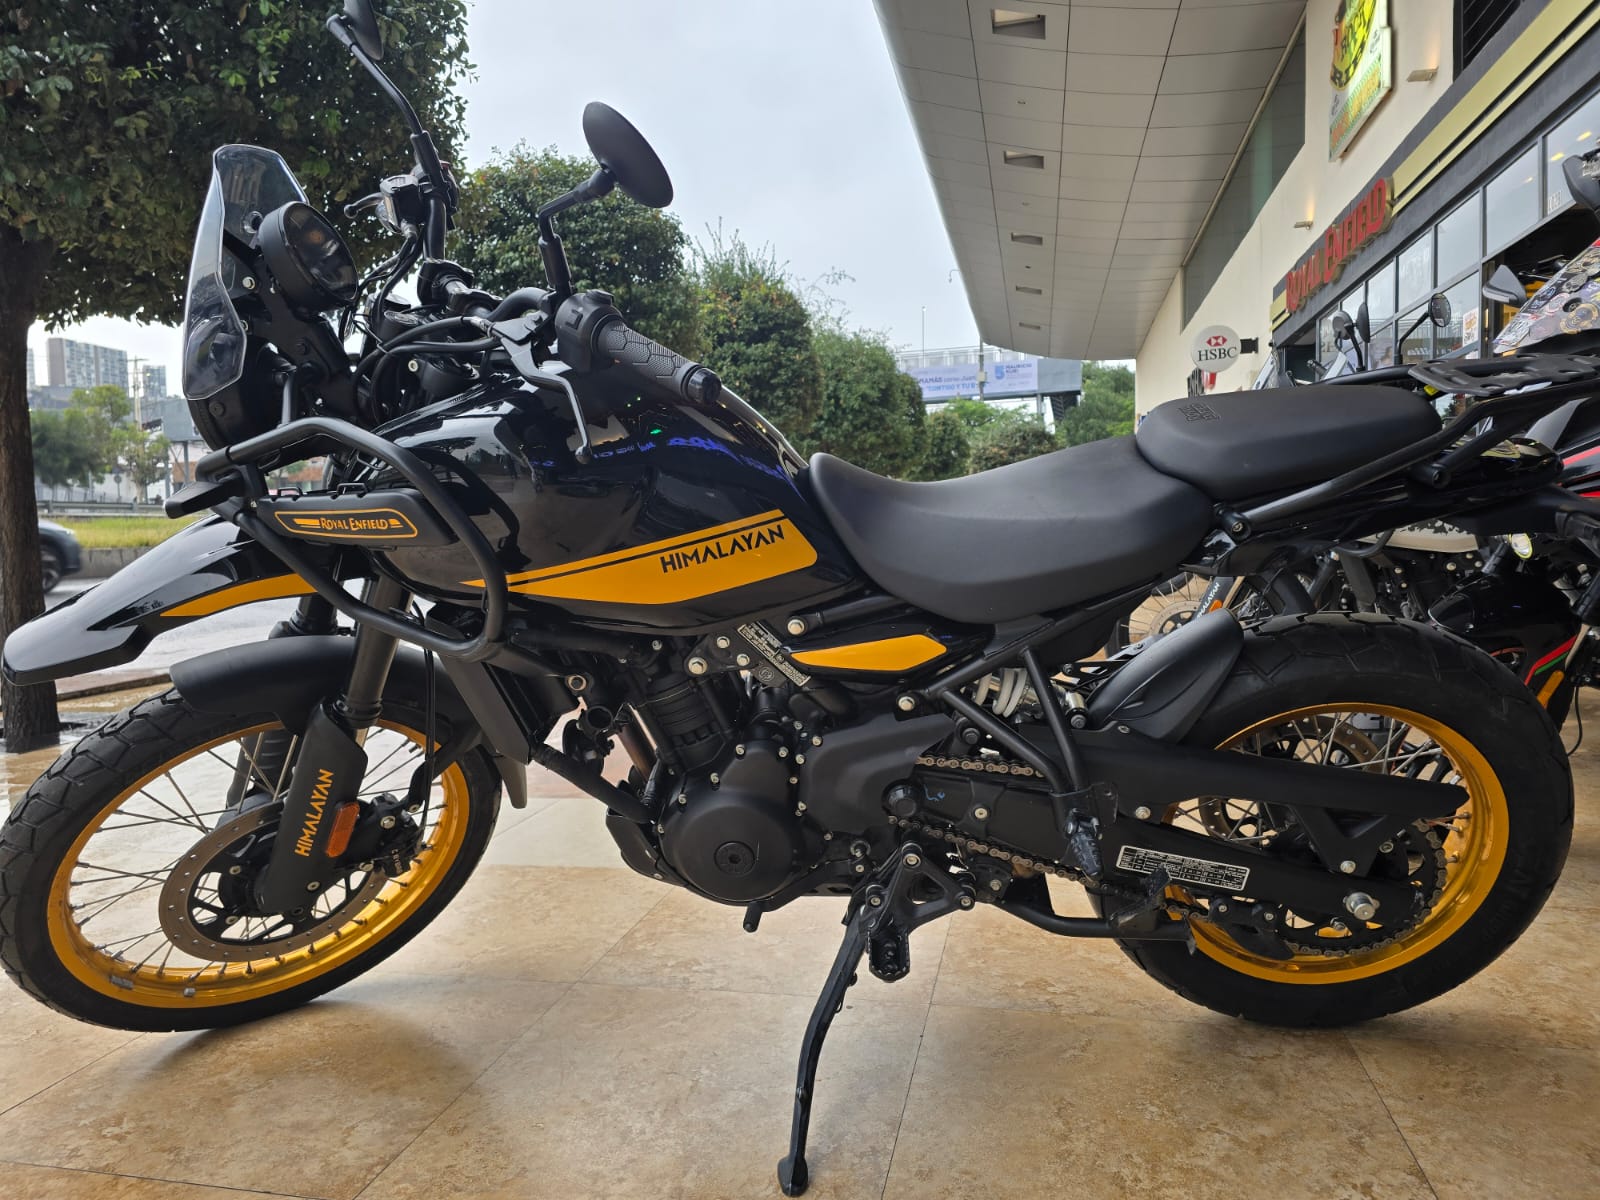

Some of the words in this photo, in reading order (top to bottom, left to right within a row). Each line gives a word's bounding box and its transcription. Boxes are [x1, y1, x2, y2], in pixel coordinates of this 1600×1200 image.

[1286, 249, 1323, 312] ROYAL
[1323, 178, 1390, 284] ENFIELD
[1198, 346, 1237, 361] HSBC
[319, 517, 349, 530] ROYAL
[349, 517, 389, 531] ENFIELD
[659, 524, 785, 573] HIMALAYAN
[1196, 582, 1220, 618] MALAYAN
[294, 768, 334, 857] HIMALAYAN
